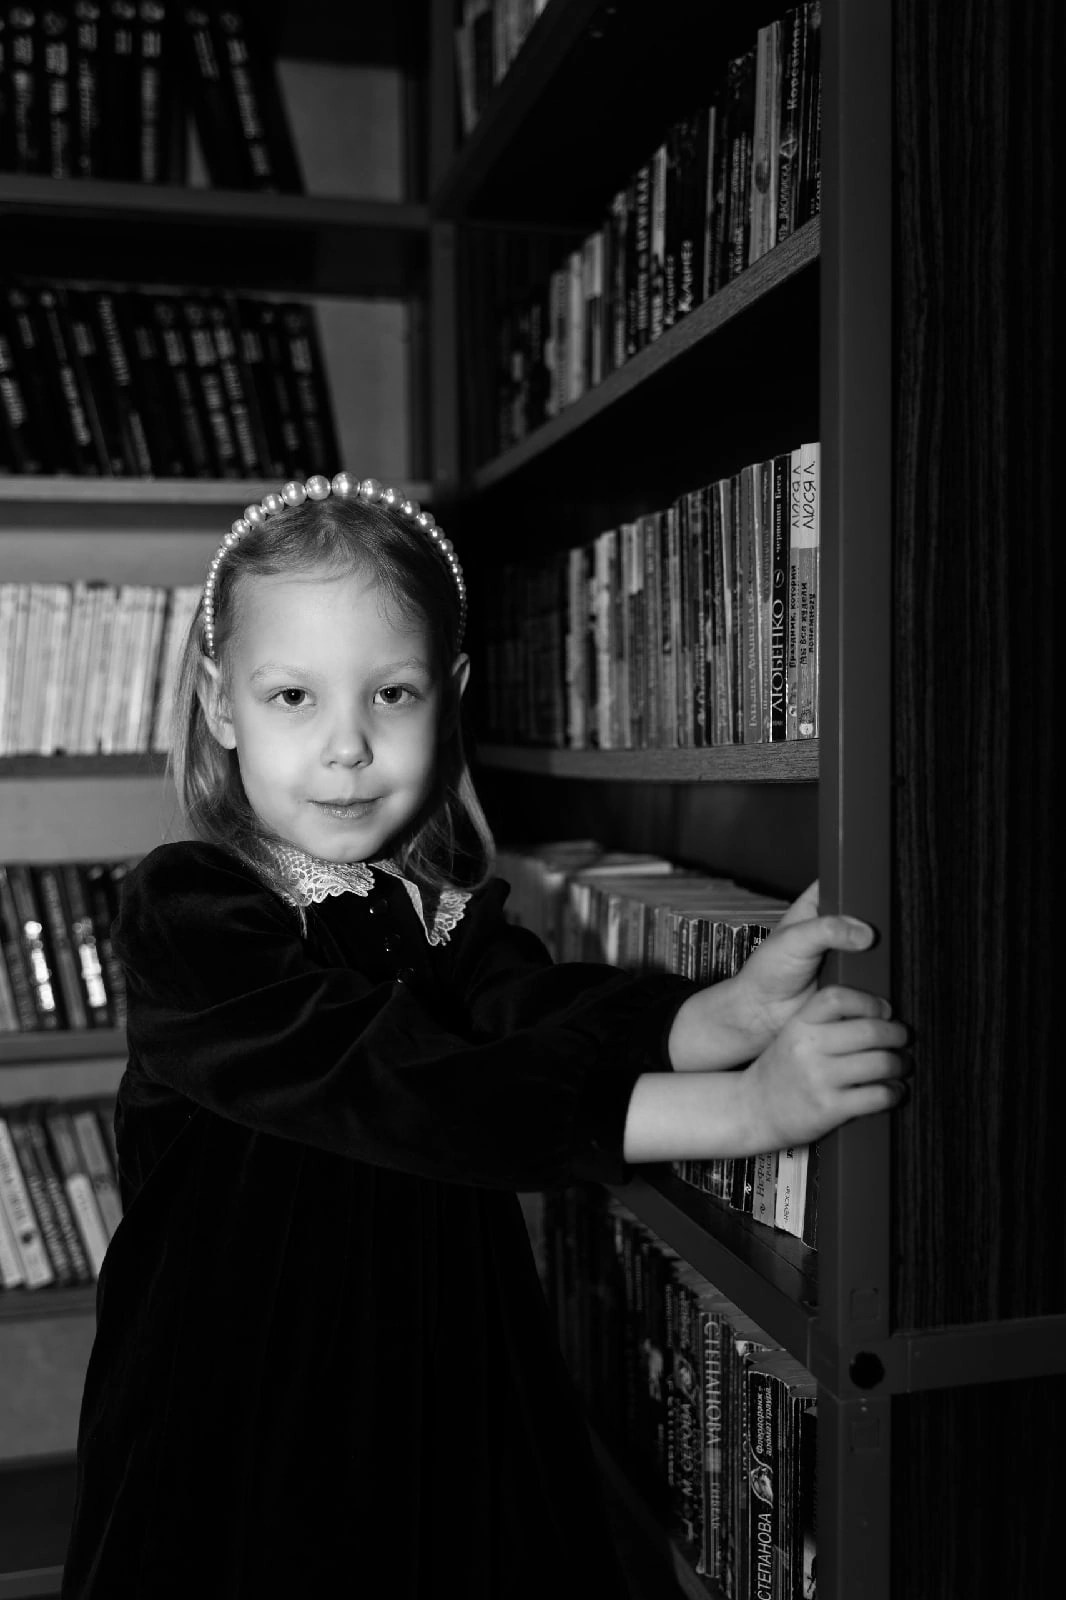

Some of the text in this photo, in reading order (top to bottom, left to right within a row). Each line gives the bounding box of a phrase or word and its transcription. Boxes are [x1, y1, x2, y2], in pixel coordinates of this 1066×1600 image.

[802, 480, 816, 530] ЛЮСЯ
[771, 599, 785, 713] ЛЮБЕНКО
[703, 1320, 722, 1445] СТЕПАНОВА
[756, 1393, 765, 1454] Флердоранж
[757, 1513, 772, 1600] СТЕПАНОВА
